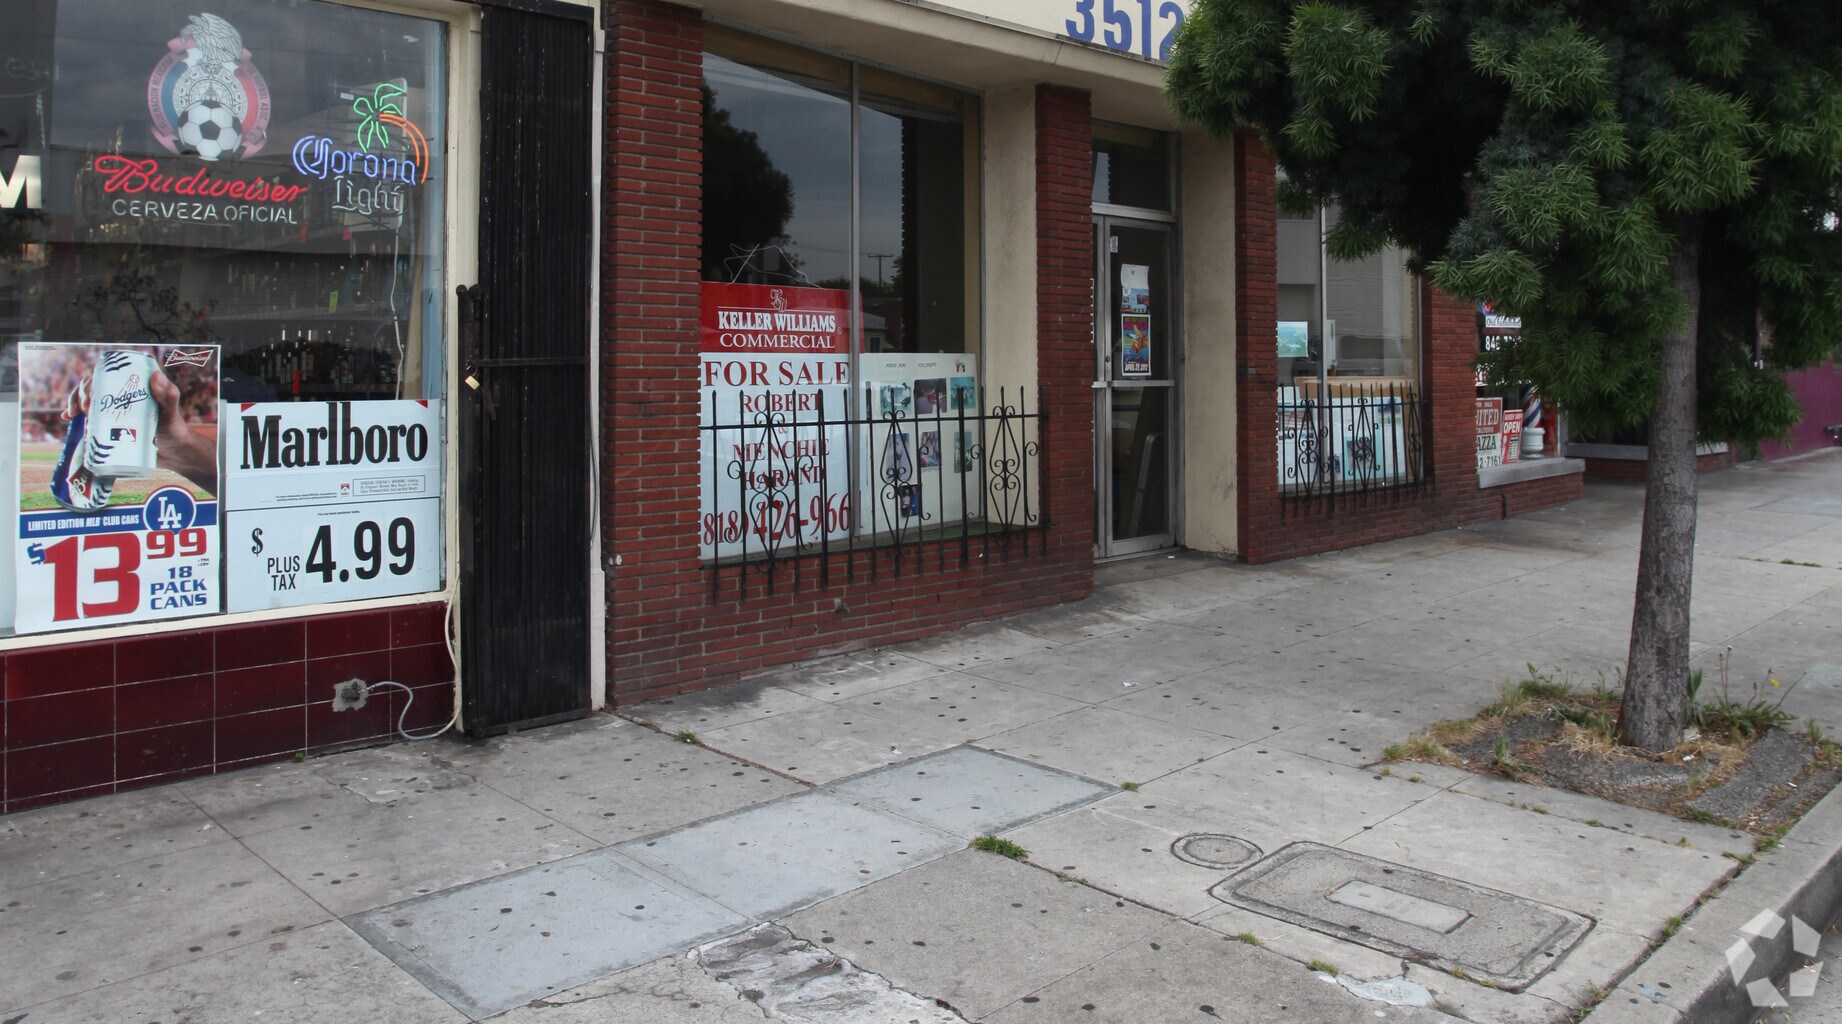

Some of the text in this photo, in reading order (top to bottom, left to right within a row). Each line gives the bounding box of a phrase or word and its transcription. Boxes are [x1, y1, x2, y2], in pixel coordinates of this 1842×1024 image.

[293, 135, 416, 186] Corona
[94, 155, 308, 203] Budweiser
[332, 175, 404, 215] Light
[112, 198, 298, 225] CERVEZA OFICIAL
[717, 311, 836, 333] KELLER WILLIAMS
[719, 333, 836, 349] COMMERCIAL
[702, 361, 850, 387] FOR SALE
[100, 387, 150, 413] Dodgers
[740, 393, 821, 414] ROBERT
[240, 401, 429, 470] Marlboro
[1503, 421, 1521, 434] OPEN
[27, 520, 57, 532] LIMITED
[57, 518, 85, 530] EDITION
[102, 516, 120, 526] CLUB
[121, 514, 140, 525] CANS
[305, 516, 416, 584] 4.99
[168, 566, 193, 579] 18
[267, 555, 301, 574] PLUS
[150, 579, 207, 596] PACK
[271, 573, 297, 592] TAX
[150, 593, 207, 611] CANS
